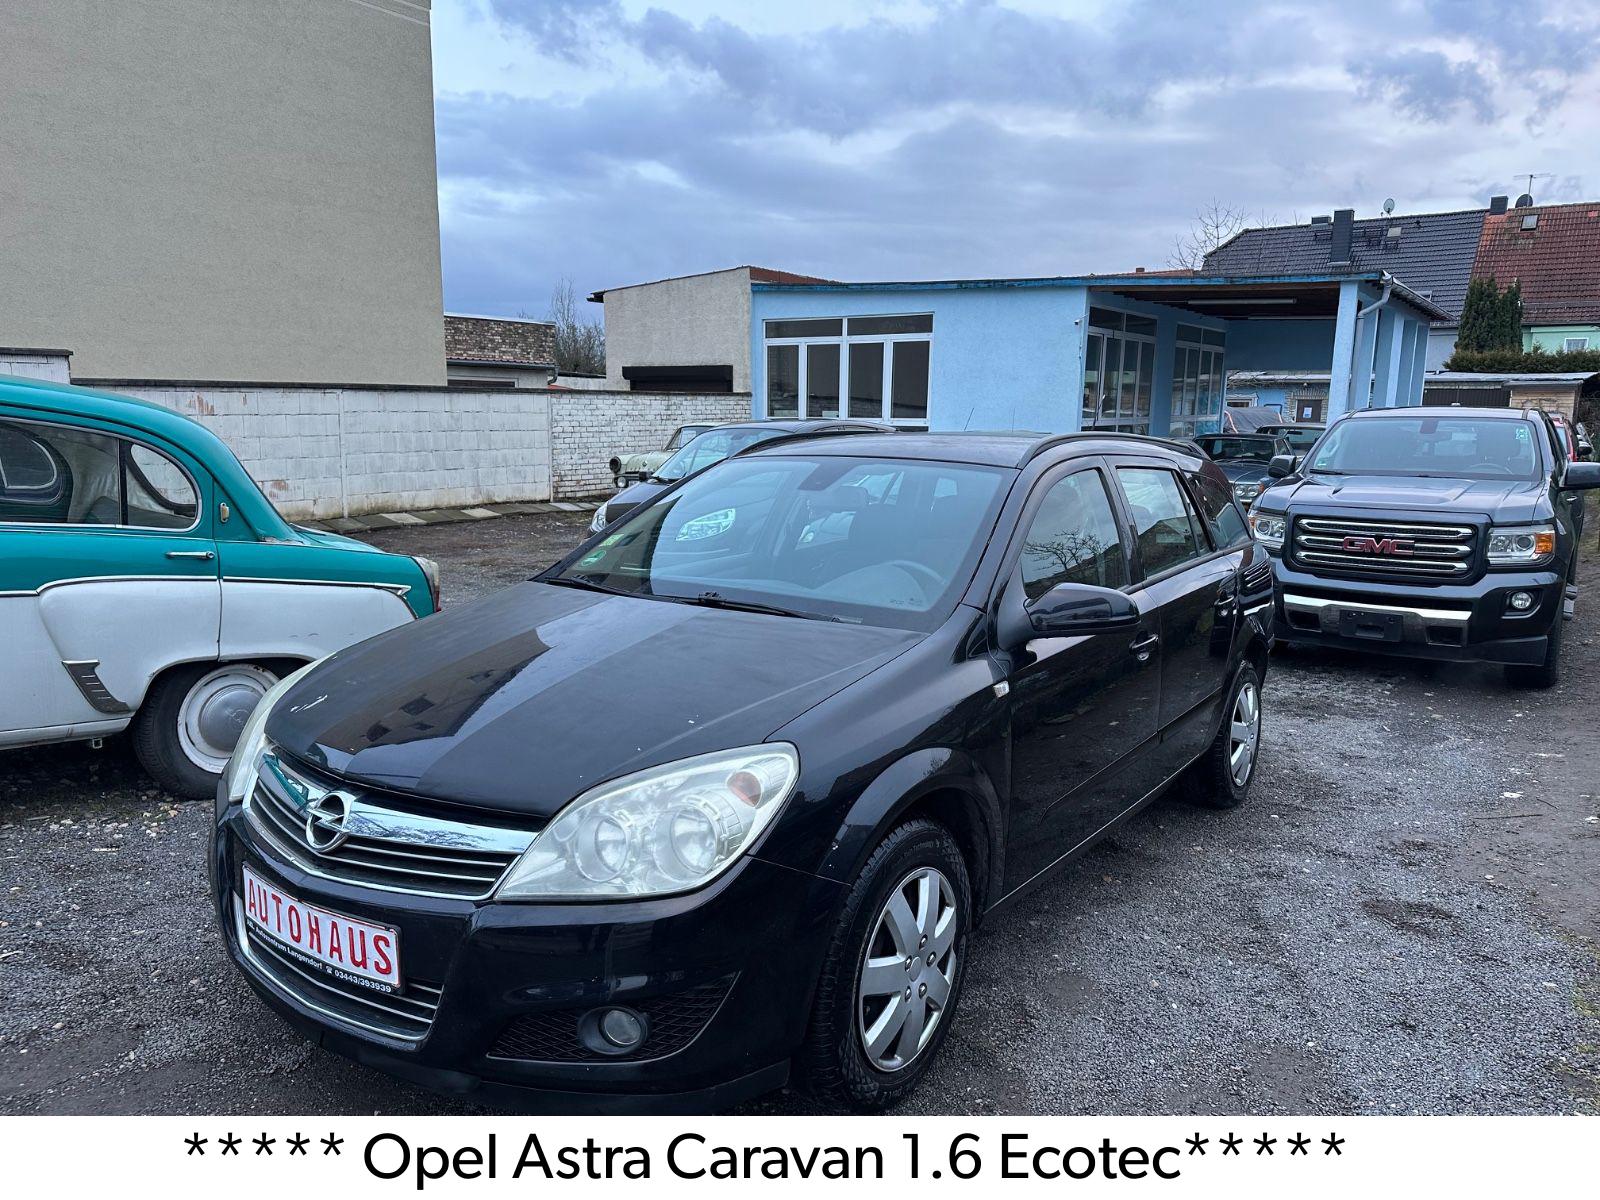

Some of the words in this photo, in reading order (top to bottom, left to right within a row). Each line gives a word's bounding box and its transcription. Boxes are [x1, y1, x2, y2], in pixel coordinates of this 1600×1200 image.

[1343, 536, 1415, 555] GMC
[248, 878, 392, 975] AUTOHAUS
[287, 946, 323, 971] Langendorf
[334, 969, 392, 993] 03443/393939
